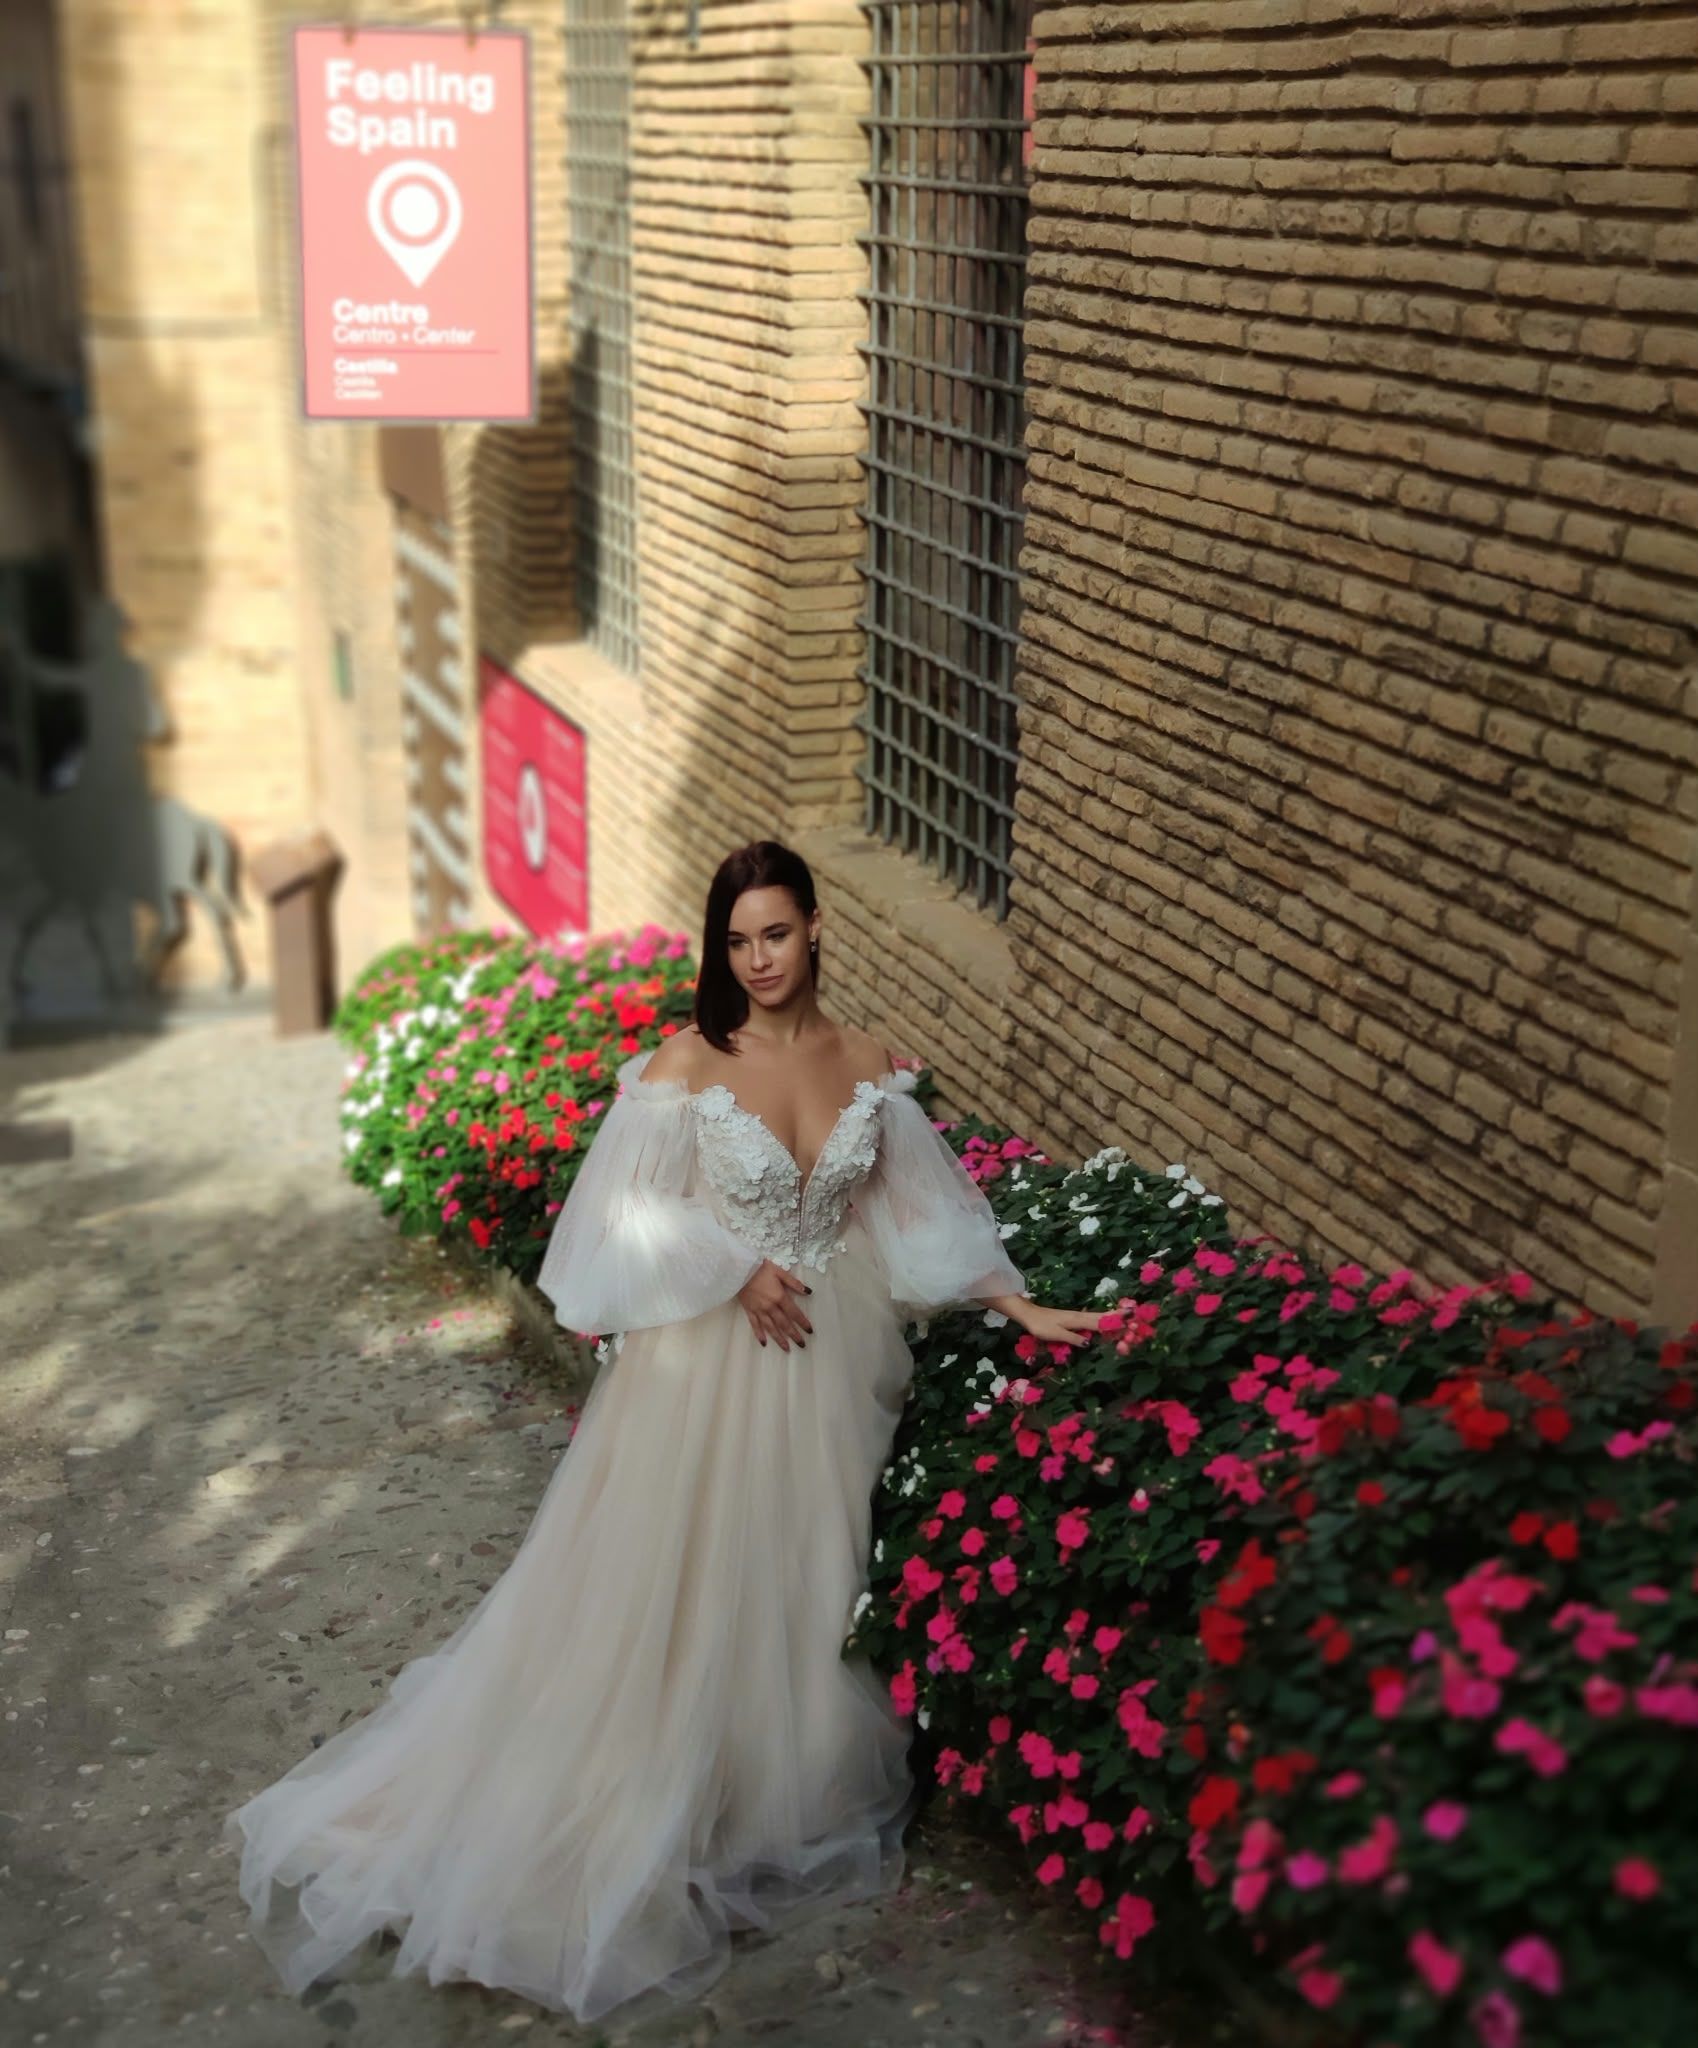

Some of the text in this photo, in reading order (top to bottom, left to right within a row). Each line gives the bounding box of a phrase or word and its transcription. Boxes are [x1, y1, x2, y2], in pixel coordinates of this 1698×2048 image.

[327, 60, 494, 113] Feeling
[327, 105, 457, 154] Spain
[333, 298, 429, 324] Centre
[333, 326, 475, 344] Centro Center
